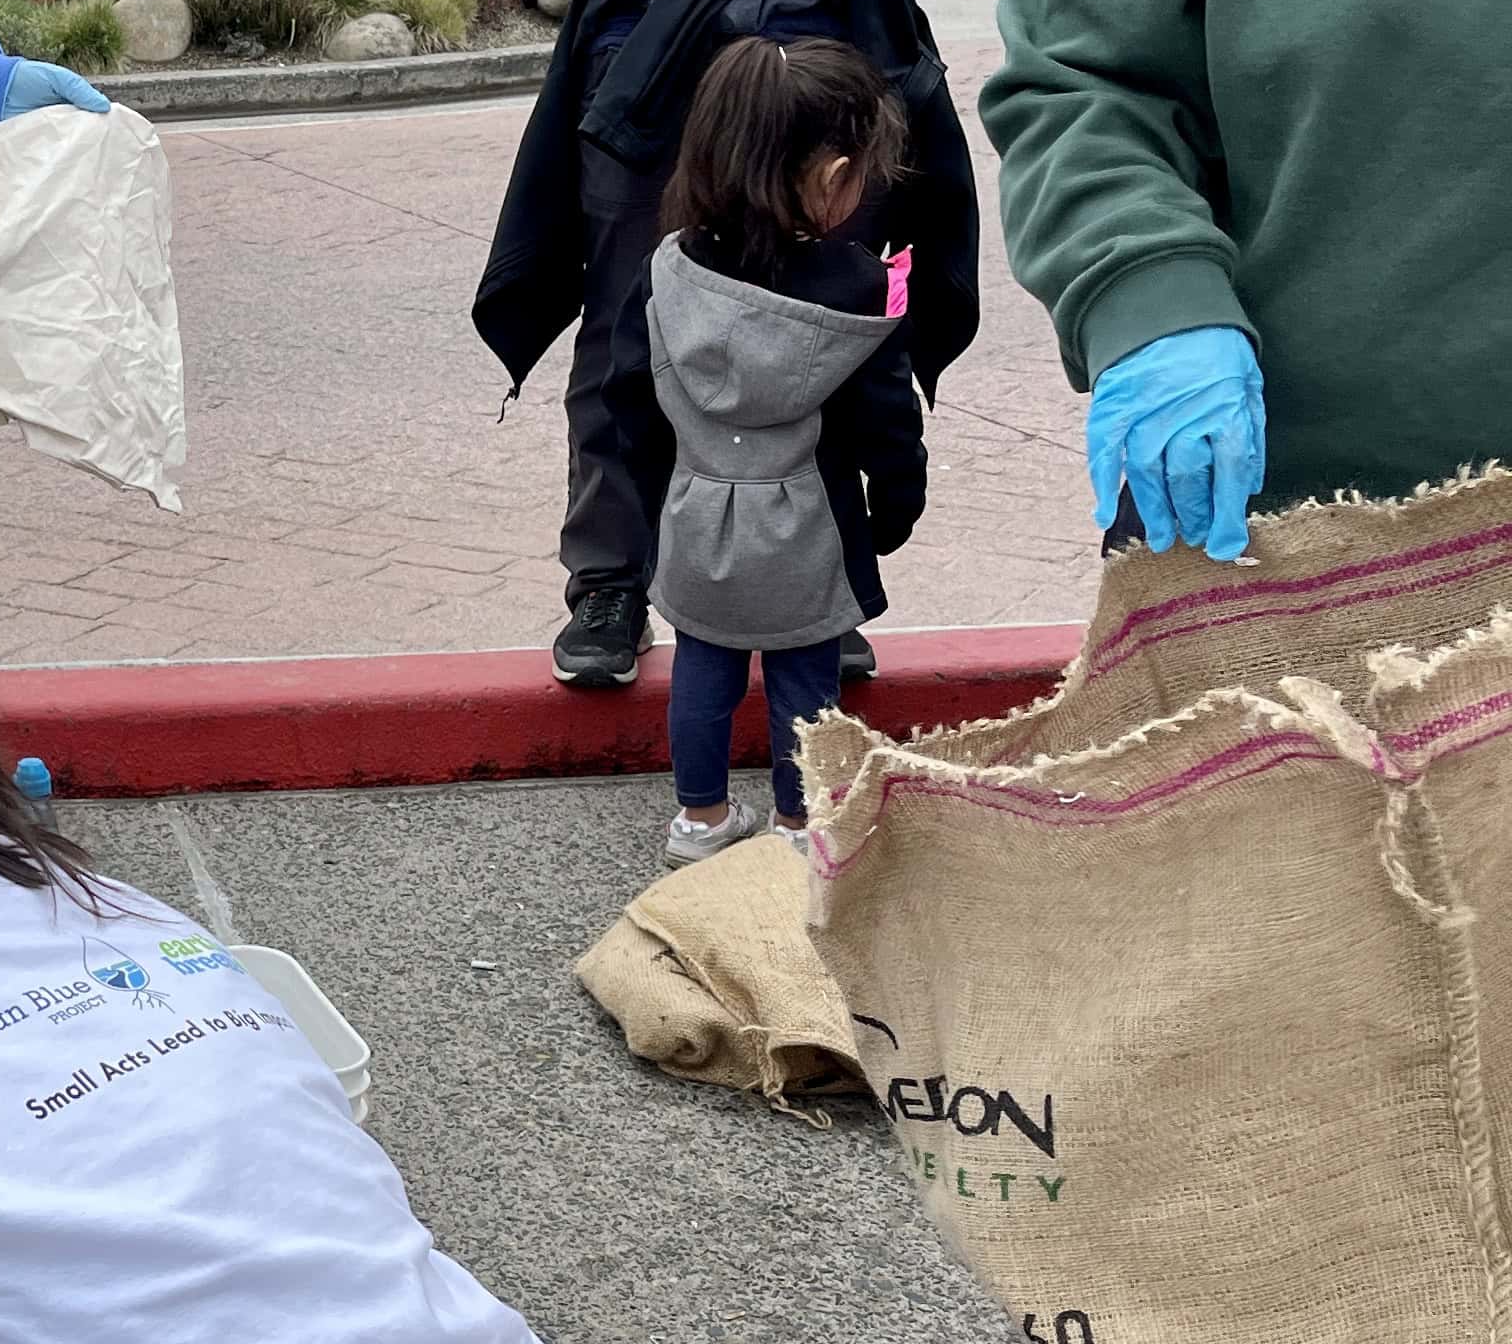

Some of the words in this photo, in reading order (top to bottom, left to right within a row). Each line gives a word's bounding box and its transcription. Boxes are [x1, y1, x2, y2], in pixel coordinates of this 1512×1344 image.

[21, 980, 92, 1013] Blue
[47, 993, 108, 1025] PROJECT
[25, 1068, 99, 1120] Small
[99, 1050, 152, 1082] Acts
[147, 1019, 207, 1056] Lead
[202, 1017, 229, 1033] to
[223, 1008, 261, 1032] Big
